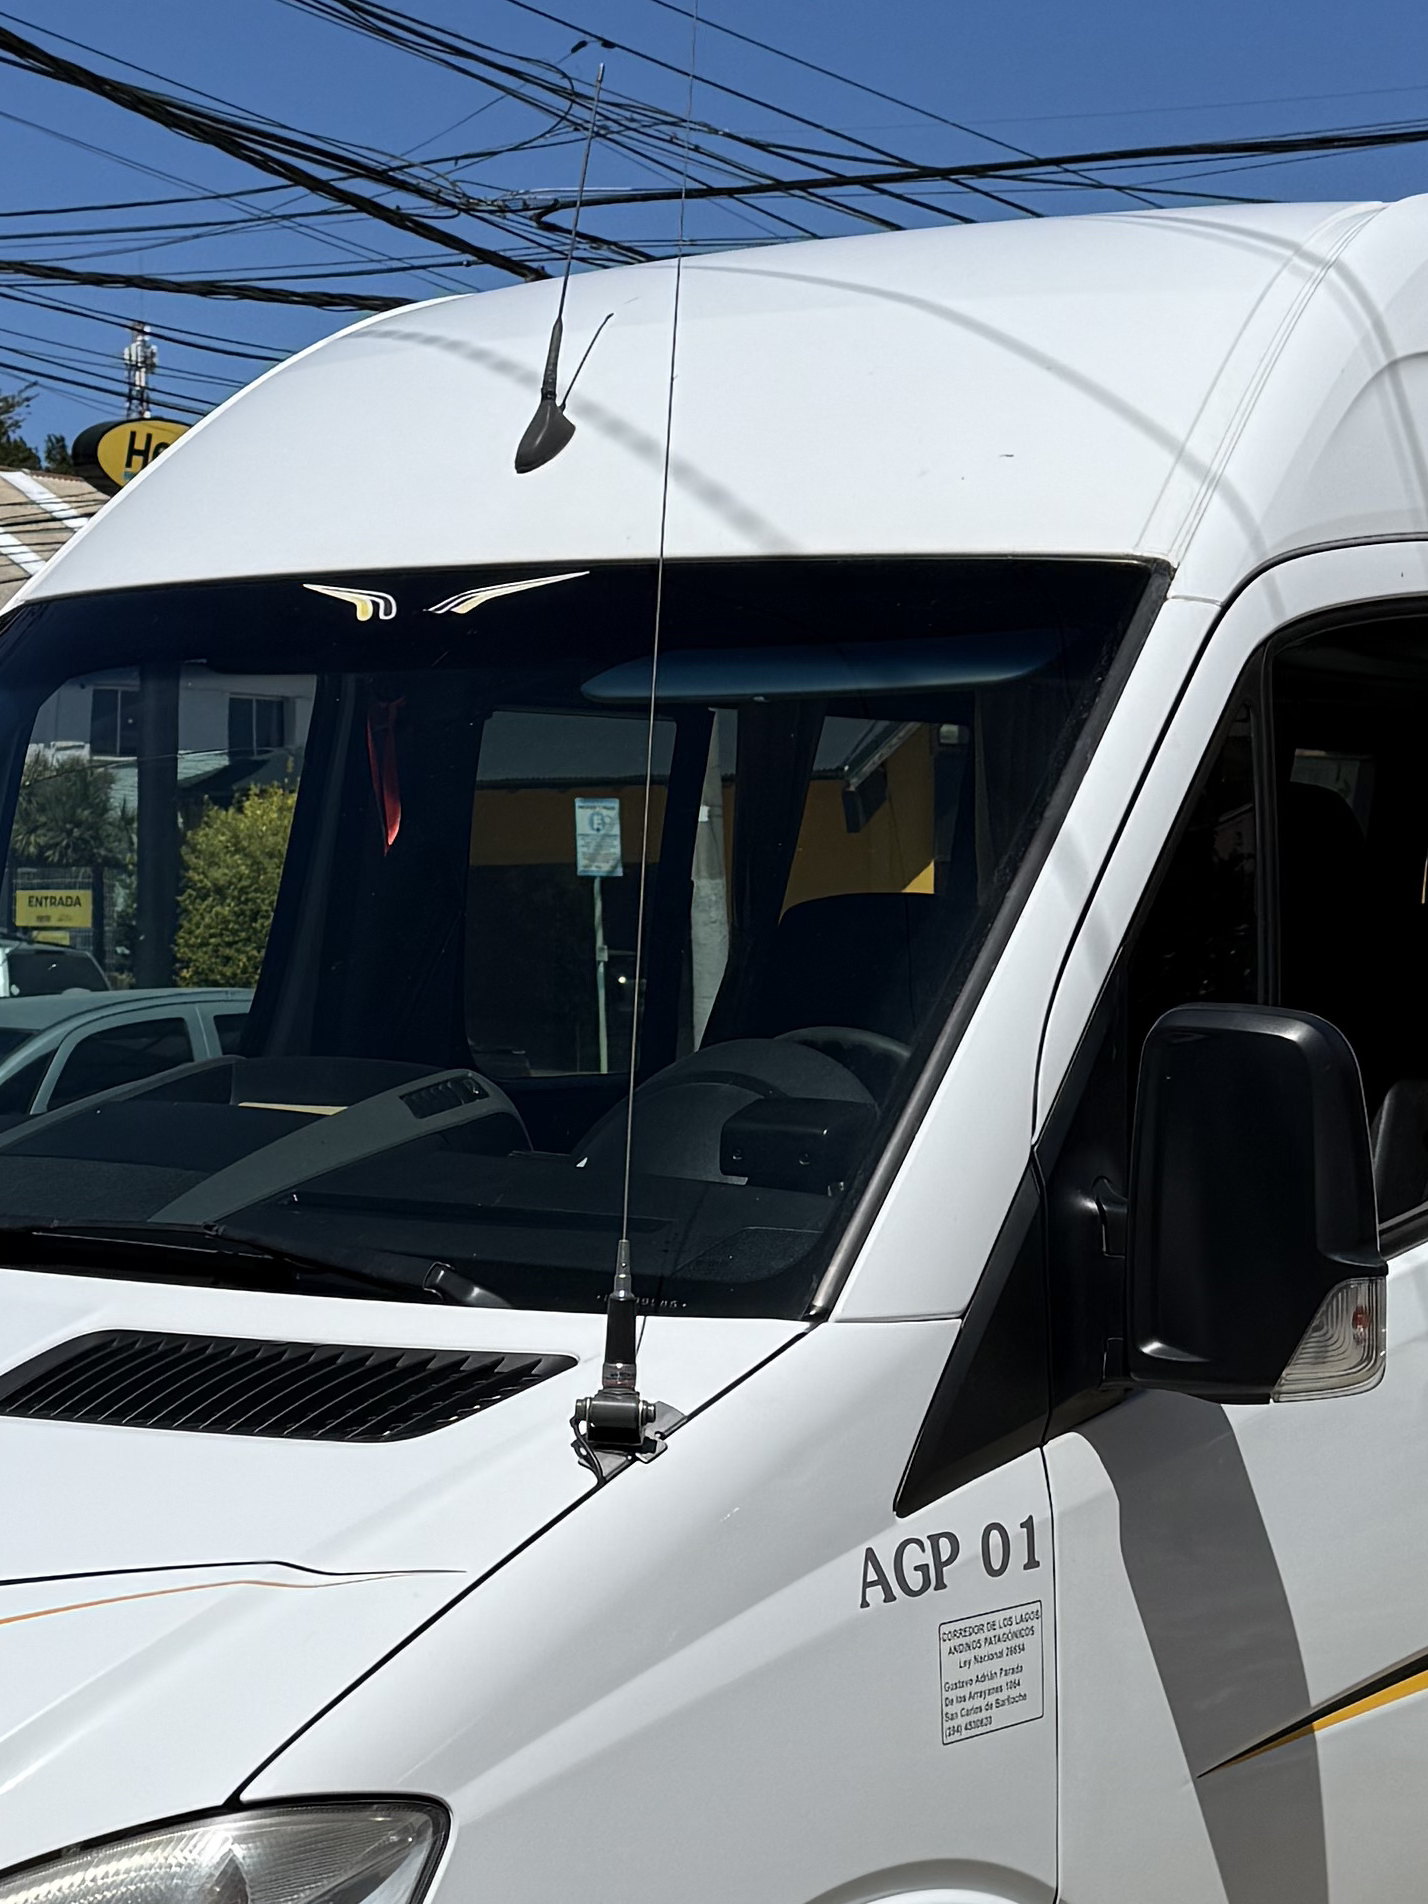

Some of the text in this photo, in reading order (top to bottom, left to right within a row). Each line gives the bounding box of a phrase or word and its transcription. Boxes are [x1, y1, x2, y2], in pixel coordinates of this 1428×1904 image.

[28, 896, 82, 907] ENTRADA
[860, 1514, 1041, 1609] AGP 01
[942, 1609, 1040, 1642] CORREDOR DE LOS LAGOS
[958, 1657, 972, 1669] Ley
[973, 1648, 1004, 1664] Nacional
[944, 1678, 974, 1692] Gustavo
[944, 1692, 1028, 1723] San Carlos de Bariloche
